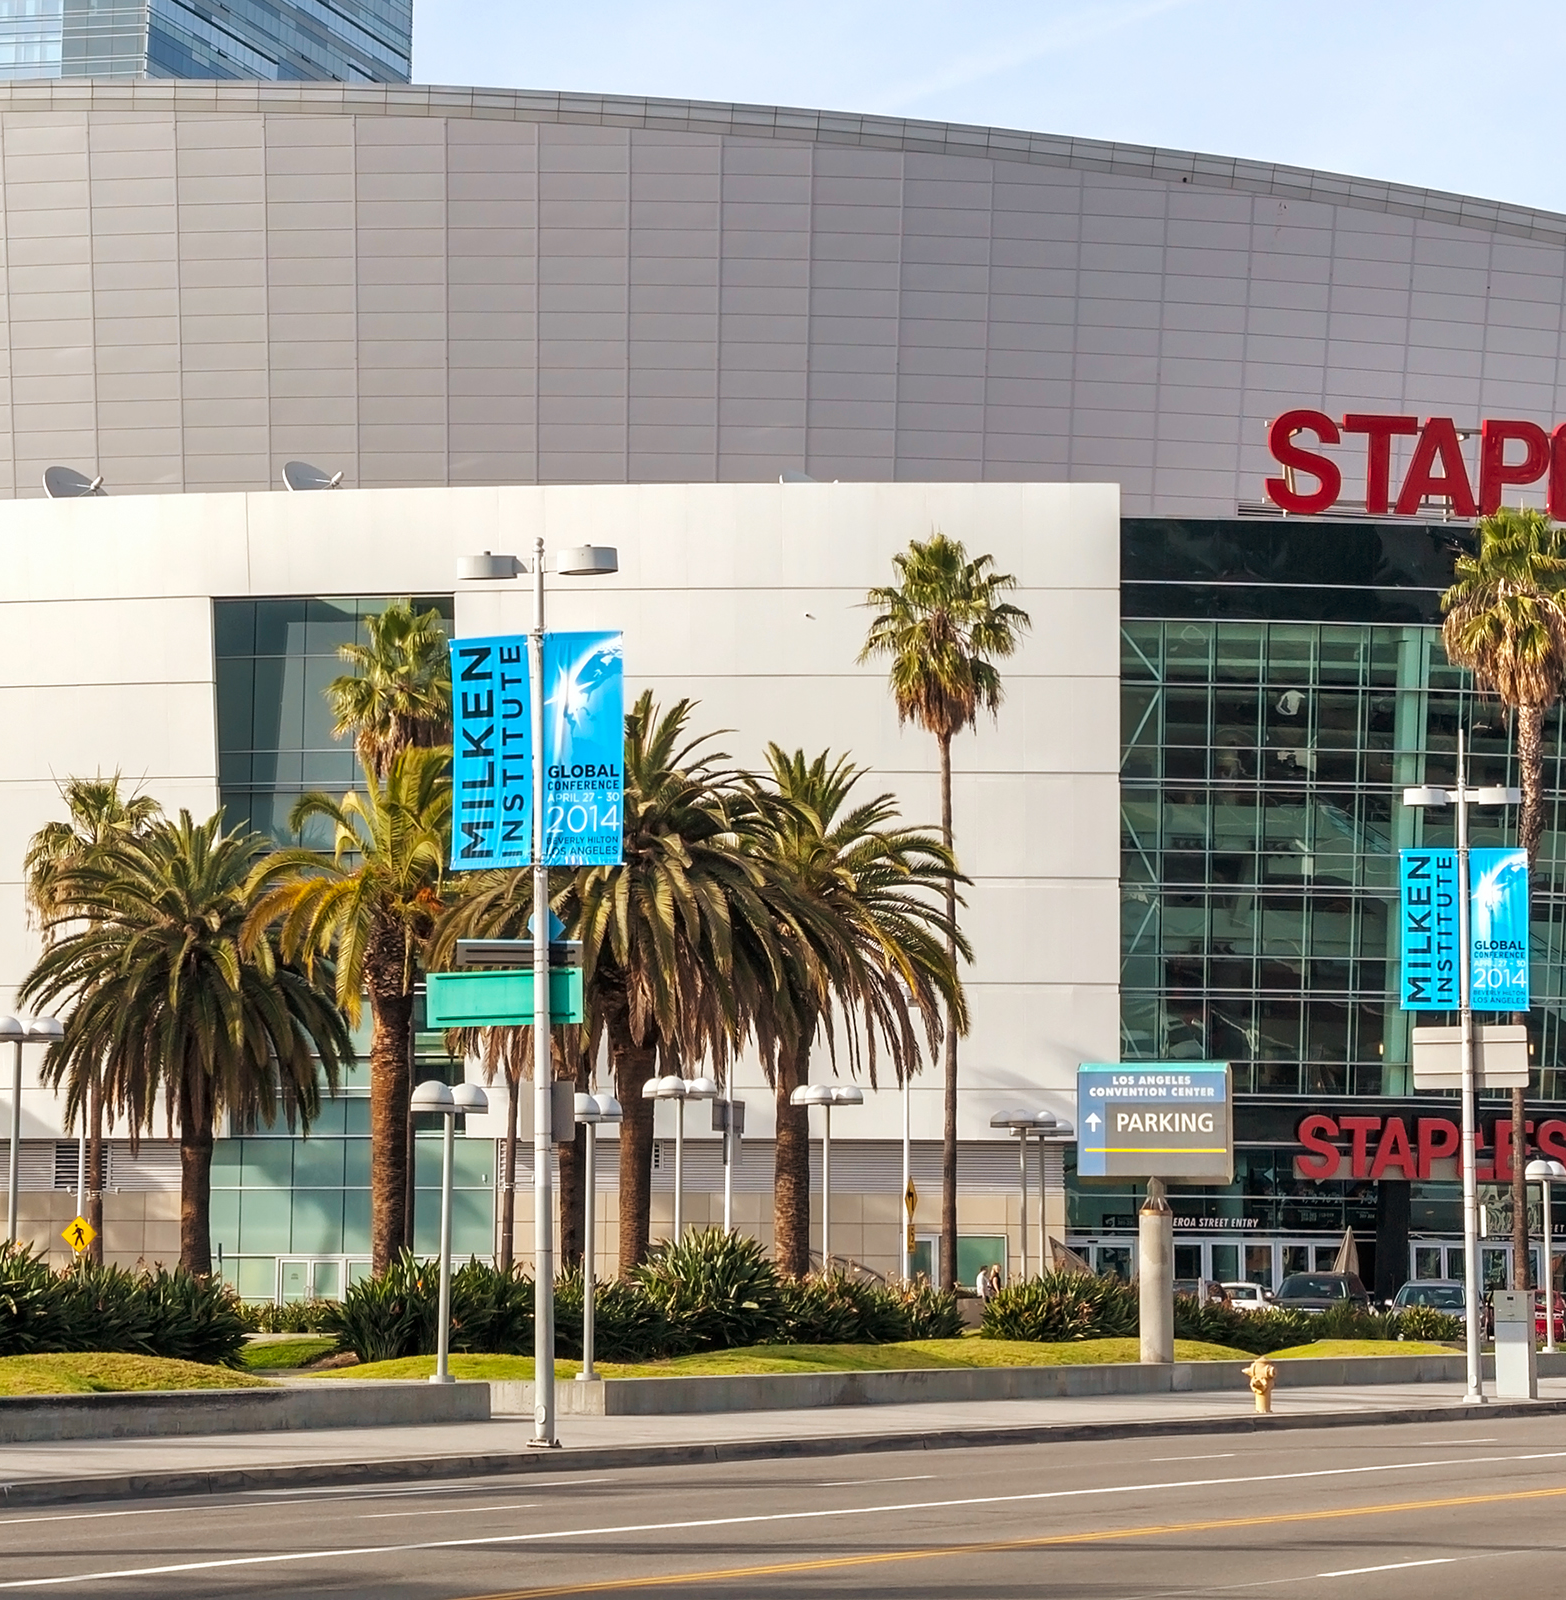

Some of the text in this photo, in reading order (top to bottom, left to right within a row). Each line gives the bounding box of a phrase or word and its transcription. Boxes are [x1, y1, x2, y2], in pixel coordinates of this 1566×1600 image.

[459, 647, 495, 859] MILKEN
[499, 645, 524, 857] INSTITUTE
[548, 764, 619, 778] GLOBAL
[547, 780, 619, 791] CONFERENCE
[547, 793, 579, 802] APRIL
[582, 793, 595, 802] 27
[606, 792, 620, 802] 30
[546, 804, 620, 833] 2014
[546, 836, 619, 845] BEVERLY HILTON
[546, 846, 618, 856] LOS ANGELES
[1407, 856, 1432, 1003] MILKEN
[1437, 856, 1453, 1003] INSTITUTE
[1474, 940, 1525, 950] GLOBAL
[1474, 951, 1525, 959] CONFERENCE
[1473, 968, 1527, 988] 2014
[1112, 1075, 1191, 1085] LOS ANGELES
[1089, 1087, 1215, 1097] CONVENTION CENTER
[1117, 1112, 1214, 1133] PARKING
[1198, 1218, 1229, 1228] STREET
[1231, 1218, 1259, 1228] ENTRY
